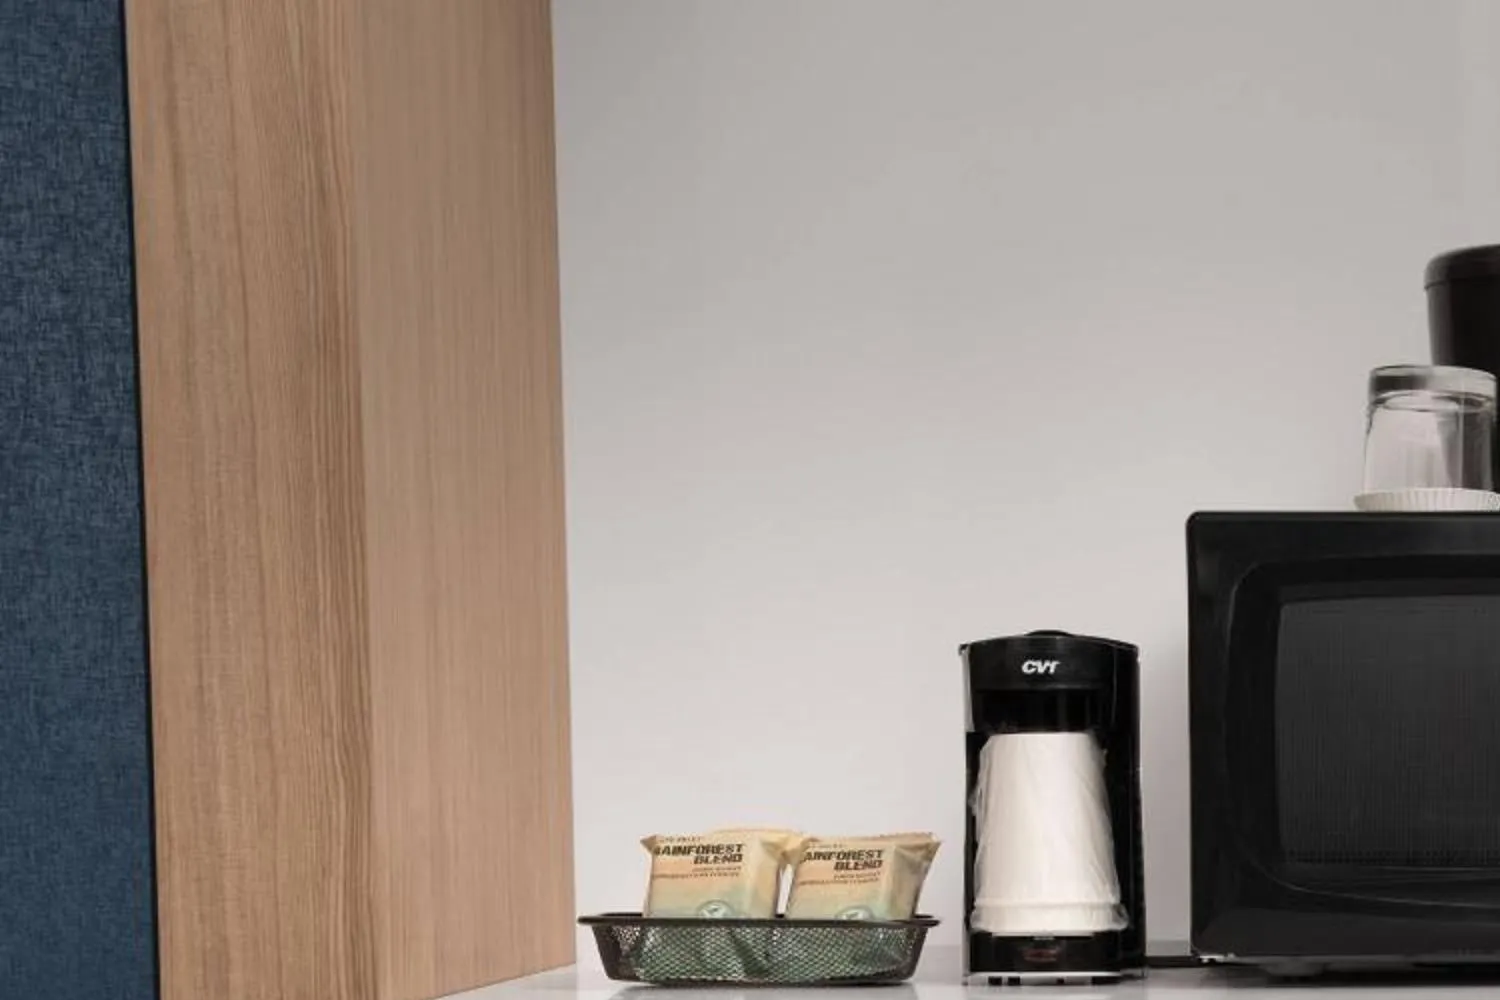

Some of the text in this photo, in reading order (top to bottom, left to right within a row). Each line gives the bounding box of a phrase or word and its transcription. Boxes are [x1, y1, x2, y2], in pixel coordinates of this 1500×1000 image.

[1022, 659, 1061, 675] CVT
[693, 853, 744, 865] BLEND
[802, 849, 884, 862] AINFOREST
[833, 859, 884, 871] BLEND
